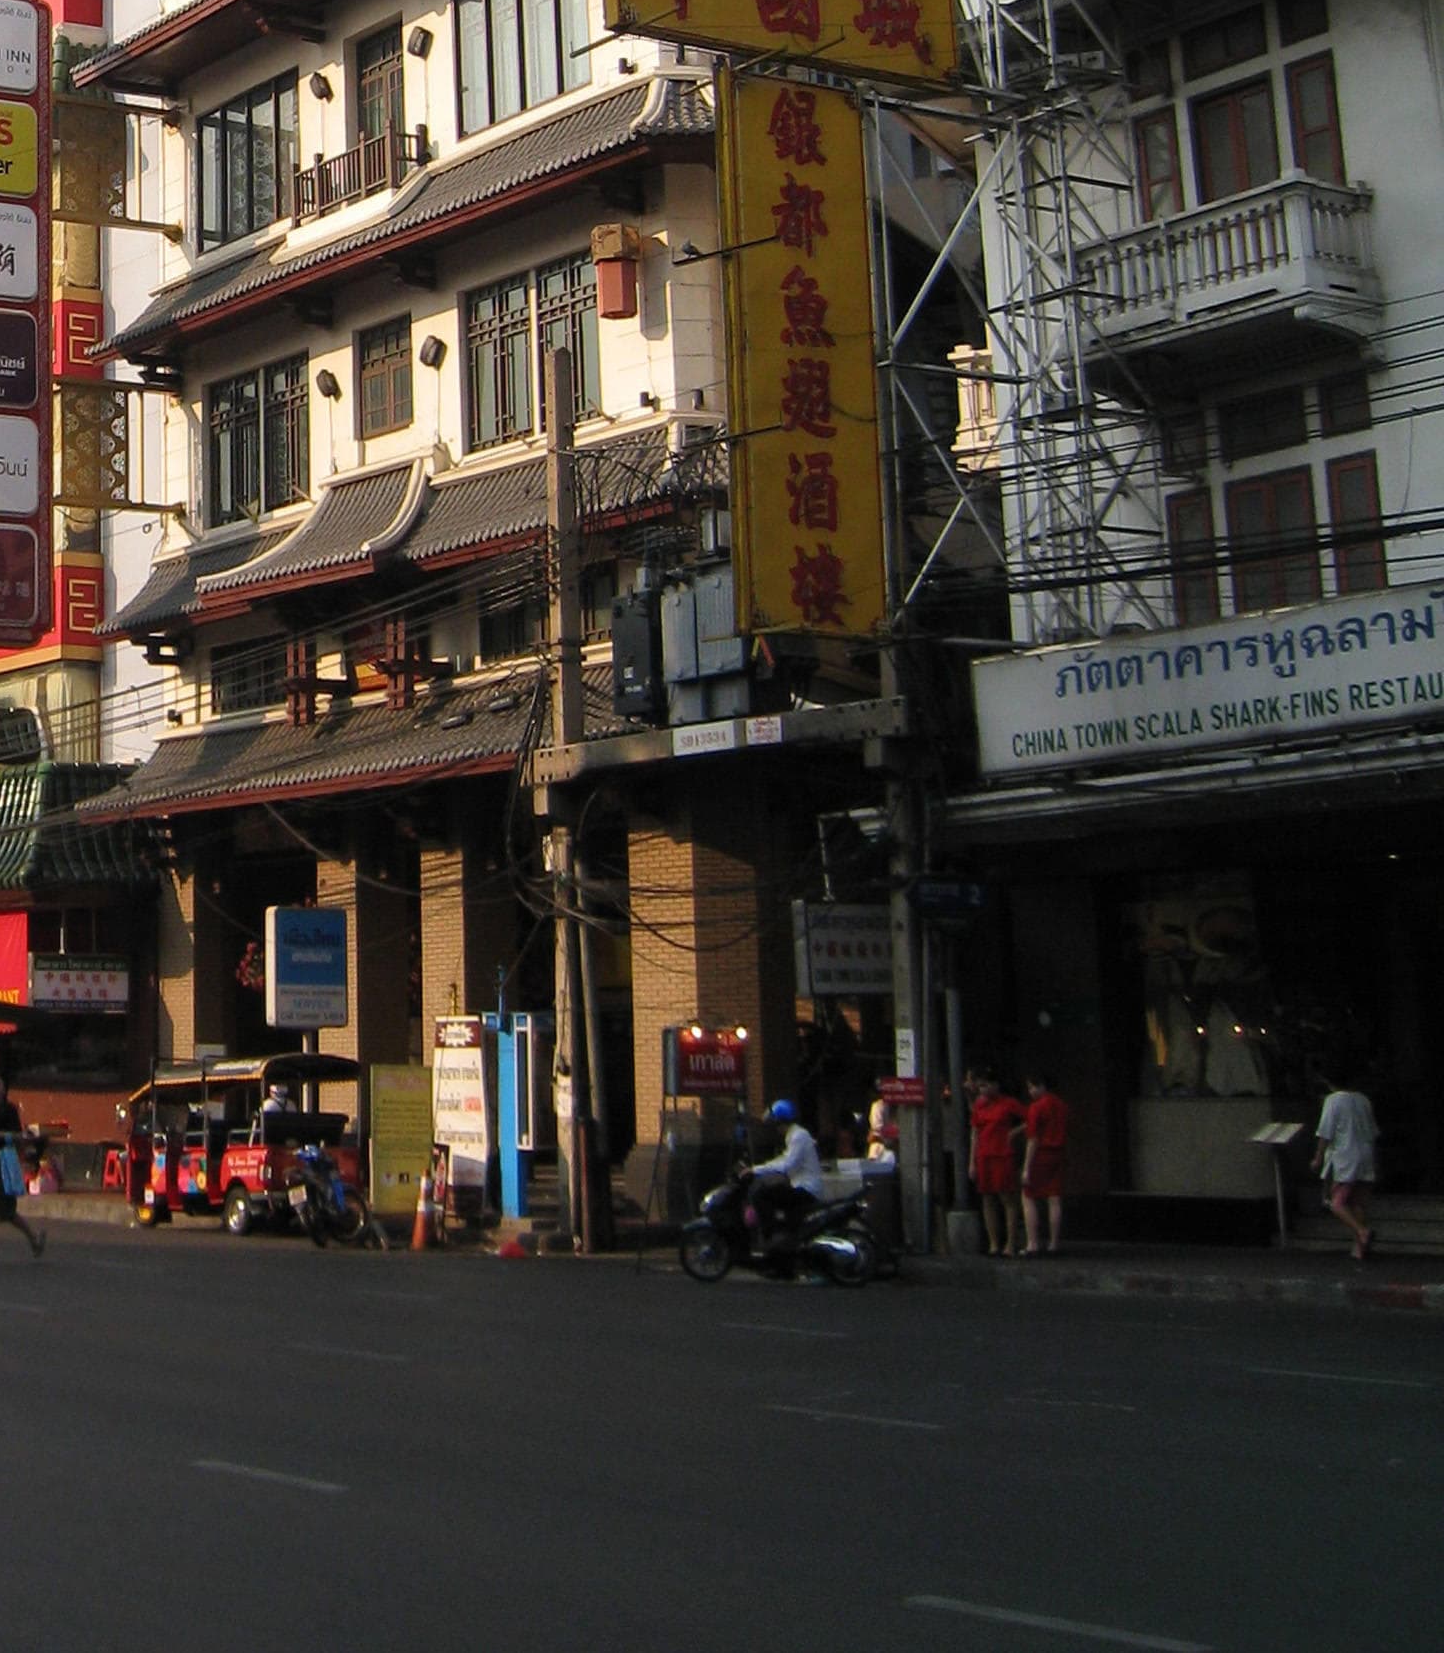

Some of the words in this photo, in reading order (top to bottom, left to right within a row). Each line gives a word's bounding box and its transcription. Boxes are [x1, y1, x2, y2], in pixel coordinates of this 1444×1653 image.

[5, 50, 32, 64] INN
[767, 87, 852, 627] 銀都魚翅酒樓
[1055, 590, 1444, 699] ภัตตาคารหูฉลาม
[1012, 727, 1066, 758] CHINA
[1073, 718, 1128, 749] TOWN
[1134, 708, 1204, 739] SCALA
[1210, 687, 1340, 731] SHARK-FINS
[1349, 672, 1444, 711] RESTAU
